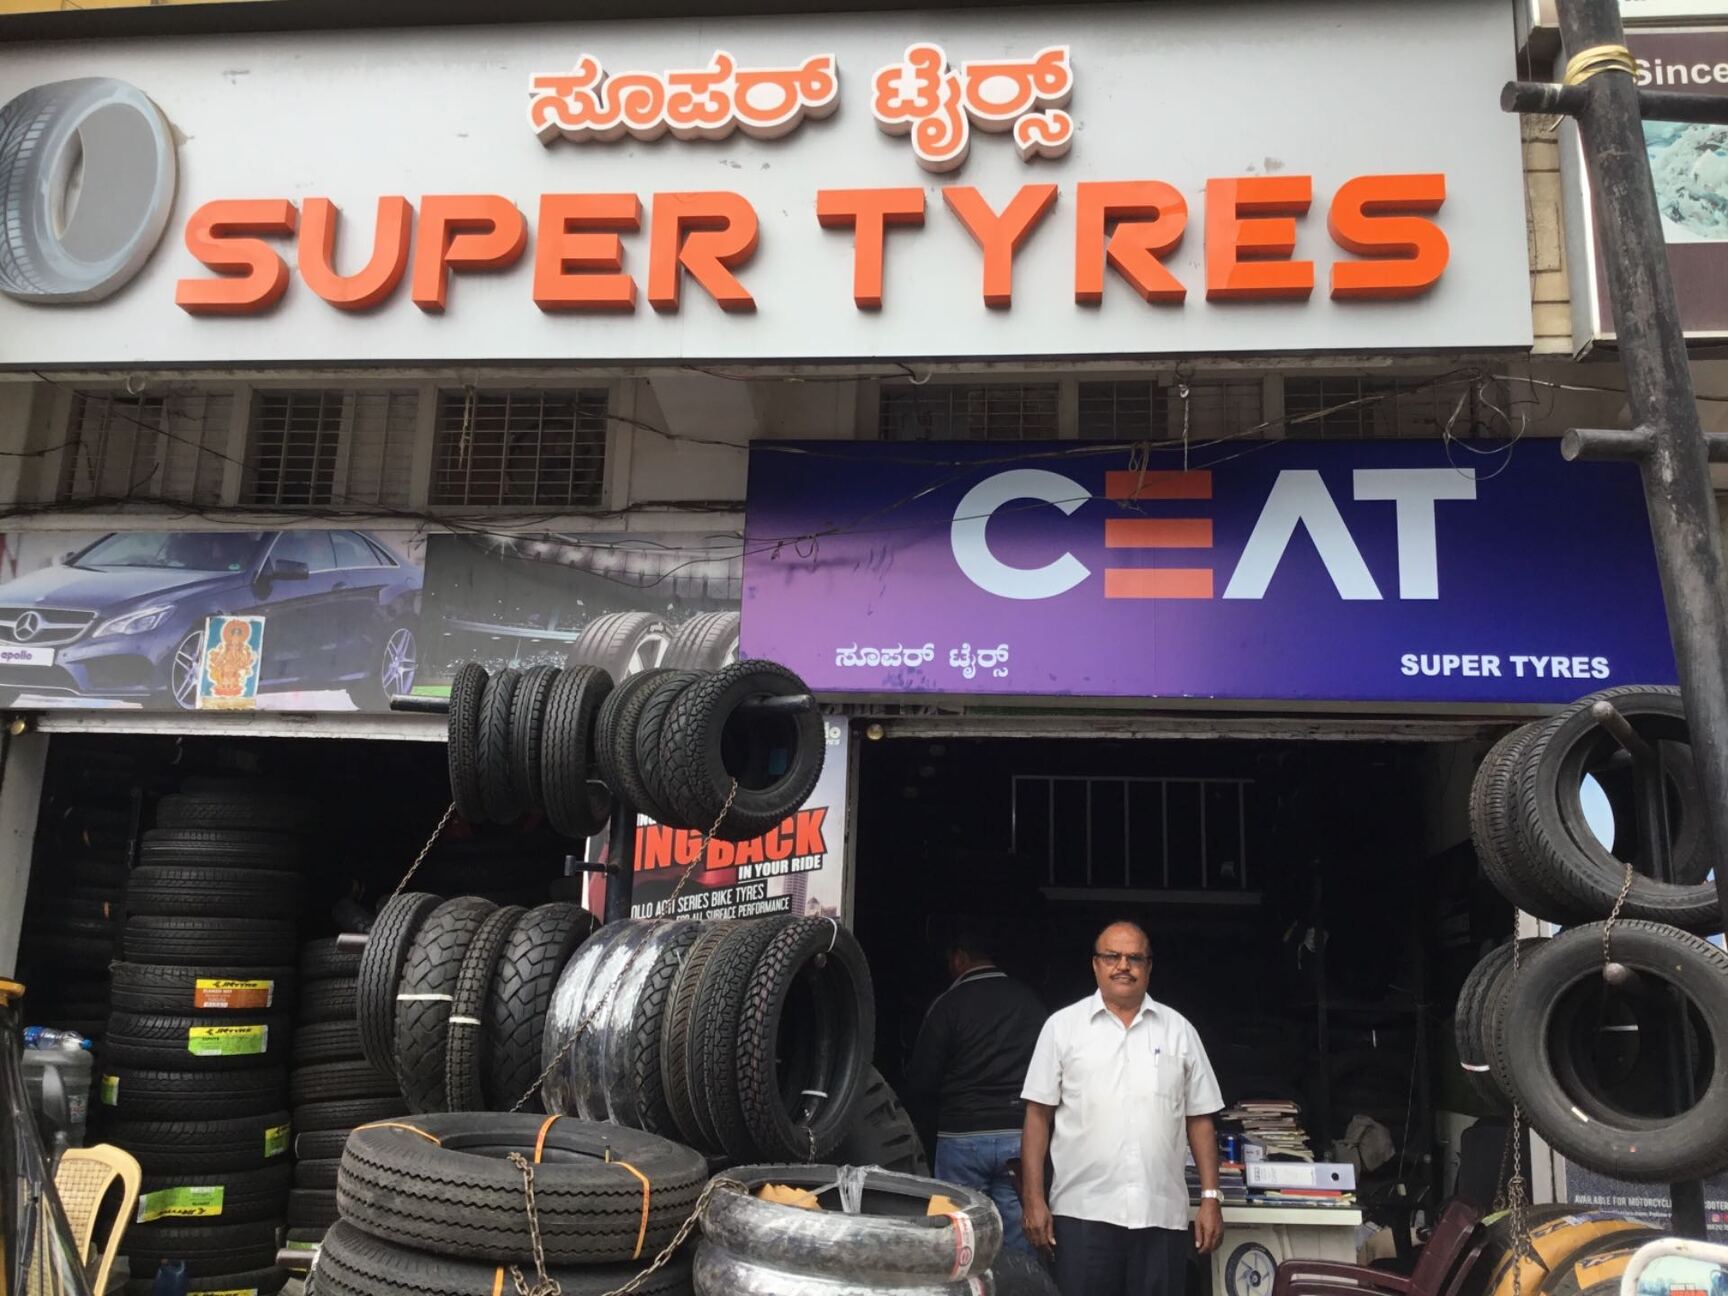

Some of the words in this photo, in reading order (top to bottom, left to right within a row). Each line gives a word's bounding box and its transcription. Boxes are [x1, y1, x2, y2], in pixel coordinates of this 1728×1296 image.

[1633, 59, 1728, 86] Since
[529, 50, 839, 133] ಸೂಪರ್
[175, 190, 759, 315] SUPER
[817, 173, 1450, 309] TYRES
[951, 468, 1477, 600] CEAT
[1, 650, 33, 661] apollo
[836, 642, 935, 667] ಸೂಪರ್
[1401, 653, 1502, 677] SUPER
[1509, 655, 1610, 679] TYRES
[634, 825, 703, 871] ING
[738, 865, 752, 880] IN
[754, 859, 789, 877] YOUR
[791, 854, 822, 872] RIDE
[631, 902, 654, 918] OLLO
[678, 893, 709, 912] SERIES
[711, 889, 732, 906] BIKE
[735, 883, 764, 902] TYRES
[738, 897, 790, 917] PERFORMANCE
[1575, 1194, 1611, 1205] AVAILABLE
[1612, 1196, 1626, 1206] FOR
